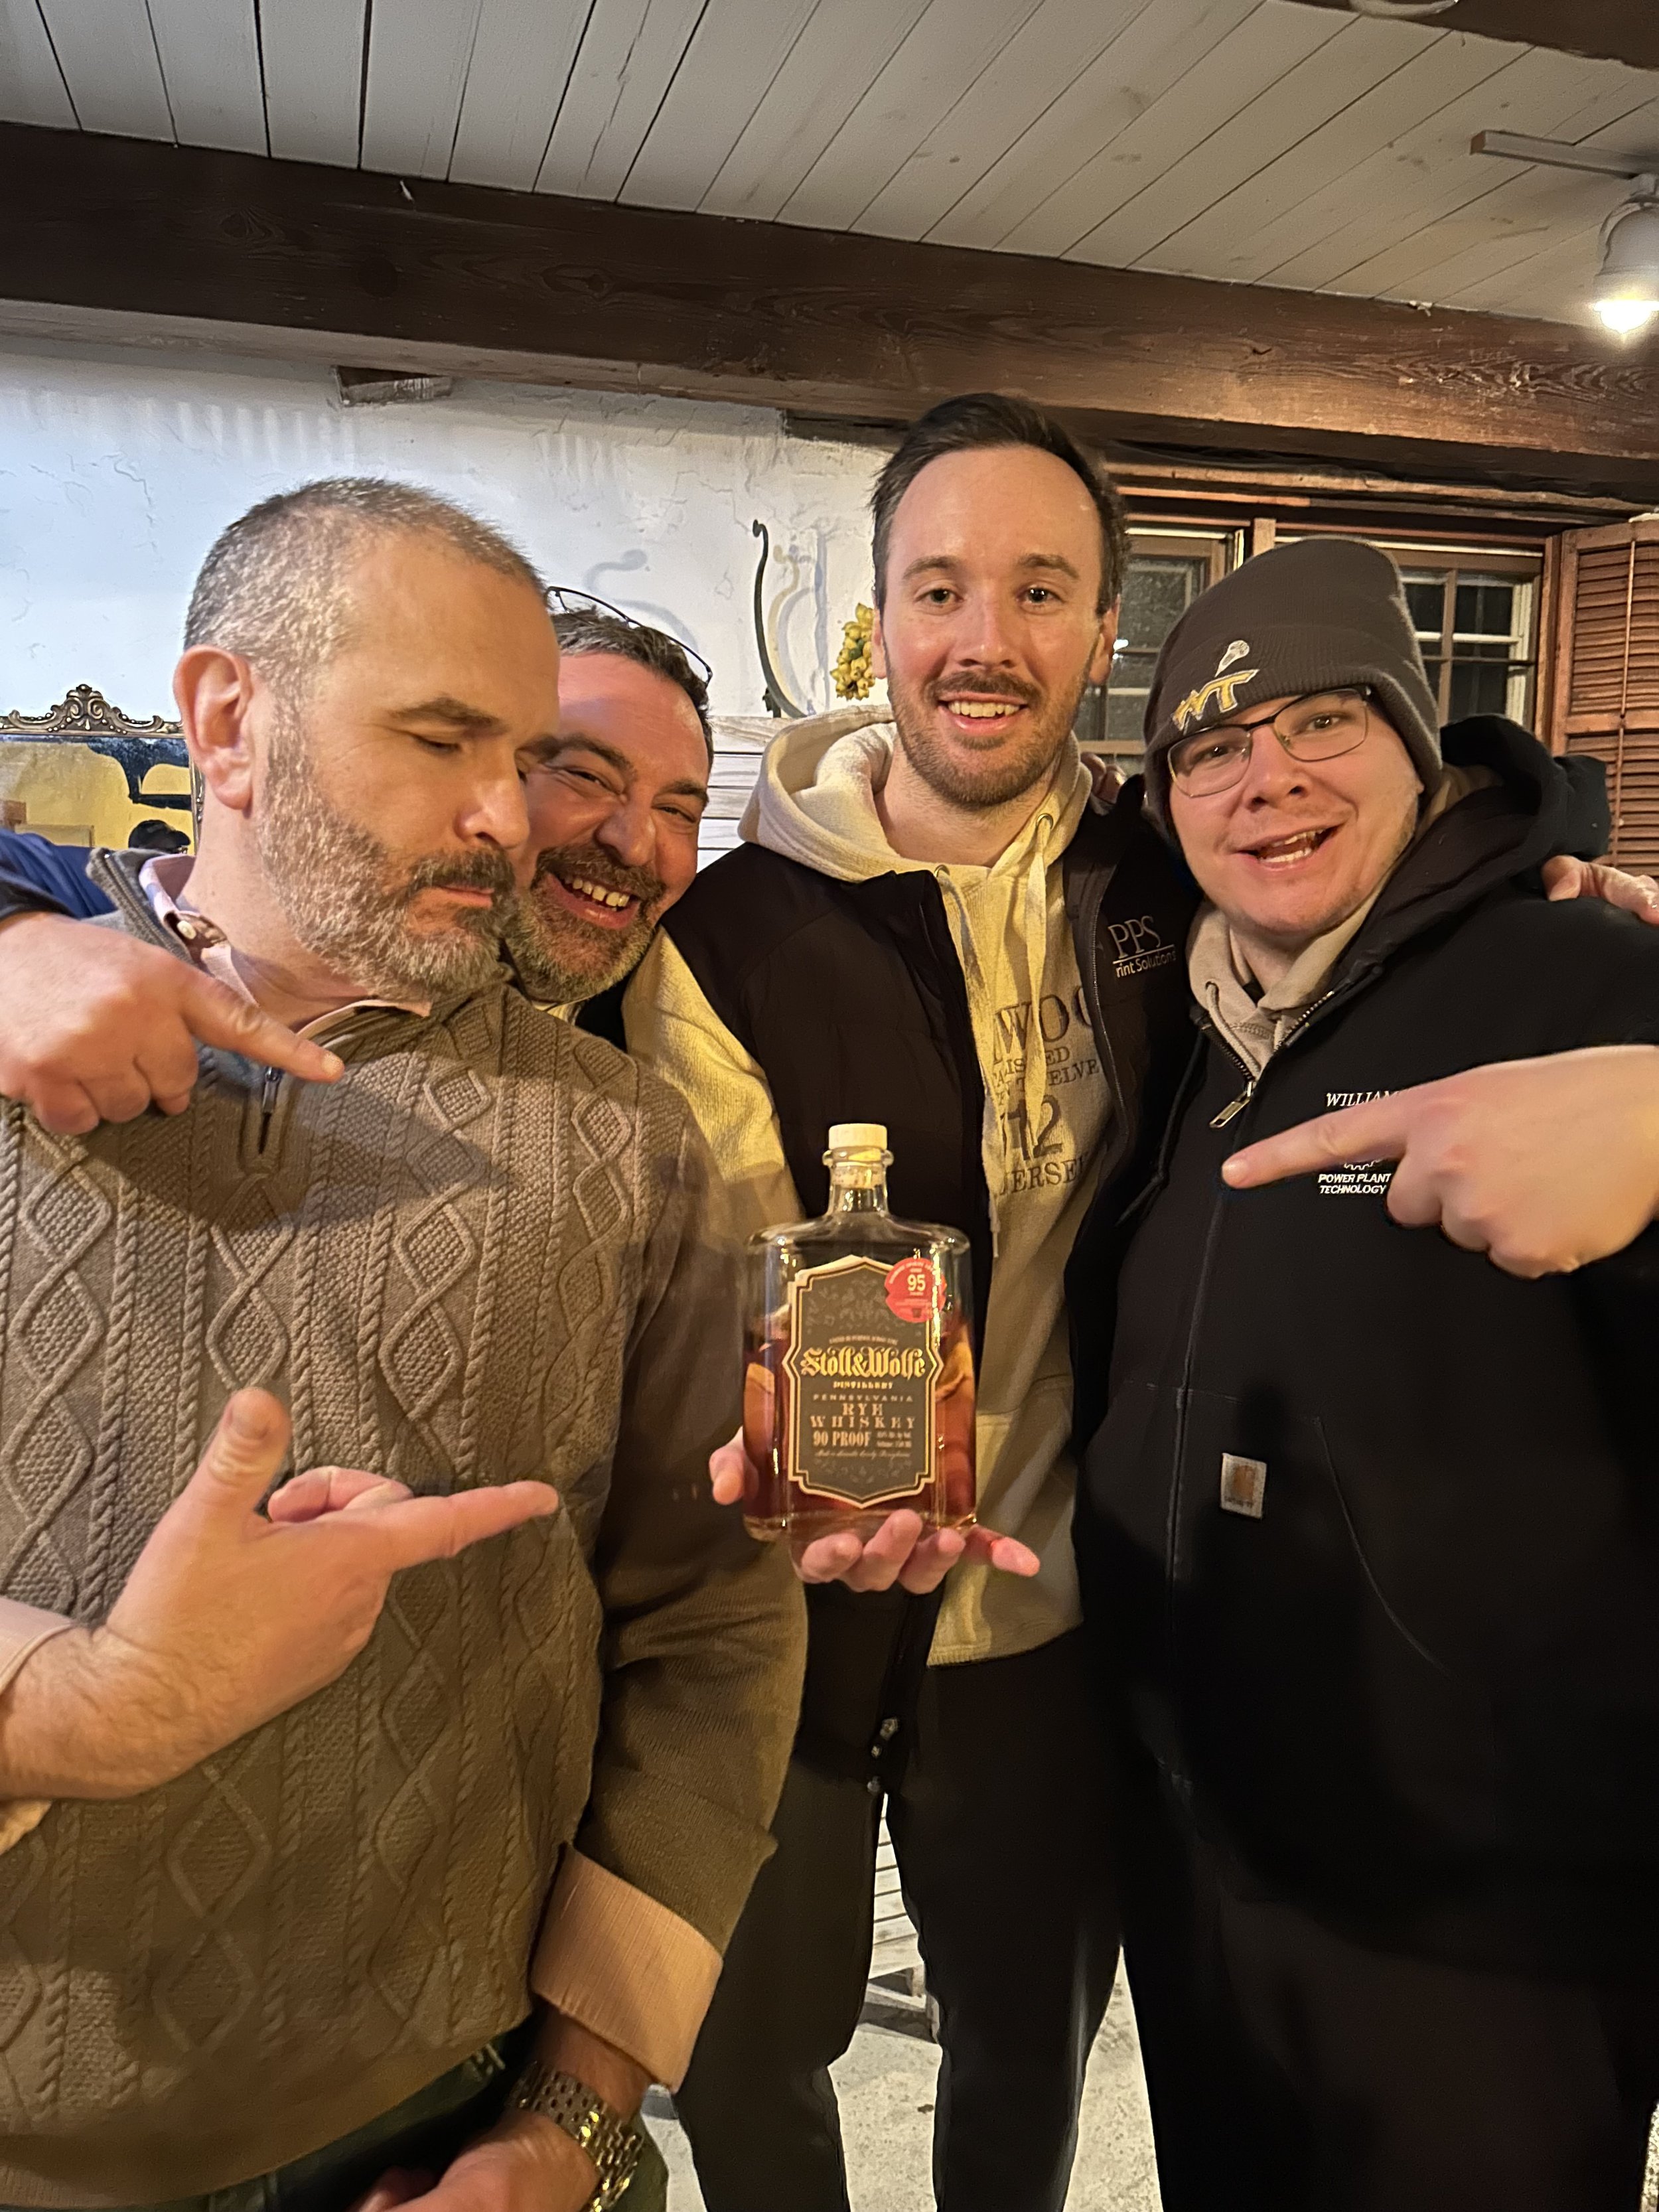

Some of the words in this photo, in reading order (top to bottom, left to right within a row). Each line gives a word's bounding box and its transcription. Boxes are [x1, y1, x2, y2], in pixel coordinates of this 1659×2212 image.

[1108, 915, 1161, 959] PPS
[1135, 950, 1177, 972] Solutions
[1016, 1059, 1100, 1092] TELVE
[1327, 1090, 1400, 1108] WILLIA
[1000, 1156, 1083, 1195] JERSE
[1317, 1174, 1356, 1183] POWER
[1356, 1173, 1392, 1183] PLANT
[1319, 1185, 1387, 1194] TECHNOLOGY
[907, 1274, 926, 1291] 95
[812, 1393, 914, 1402] PENNSYLVANIA
[810, 1416, 915, 1430] WHISKEY
[812, 1430, 829, 1447] 90
[831, 1430, 873, 1447] PROOF
